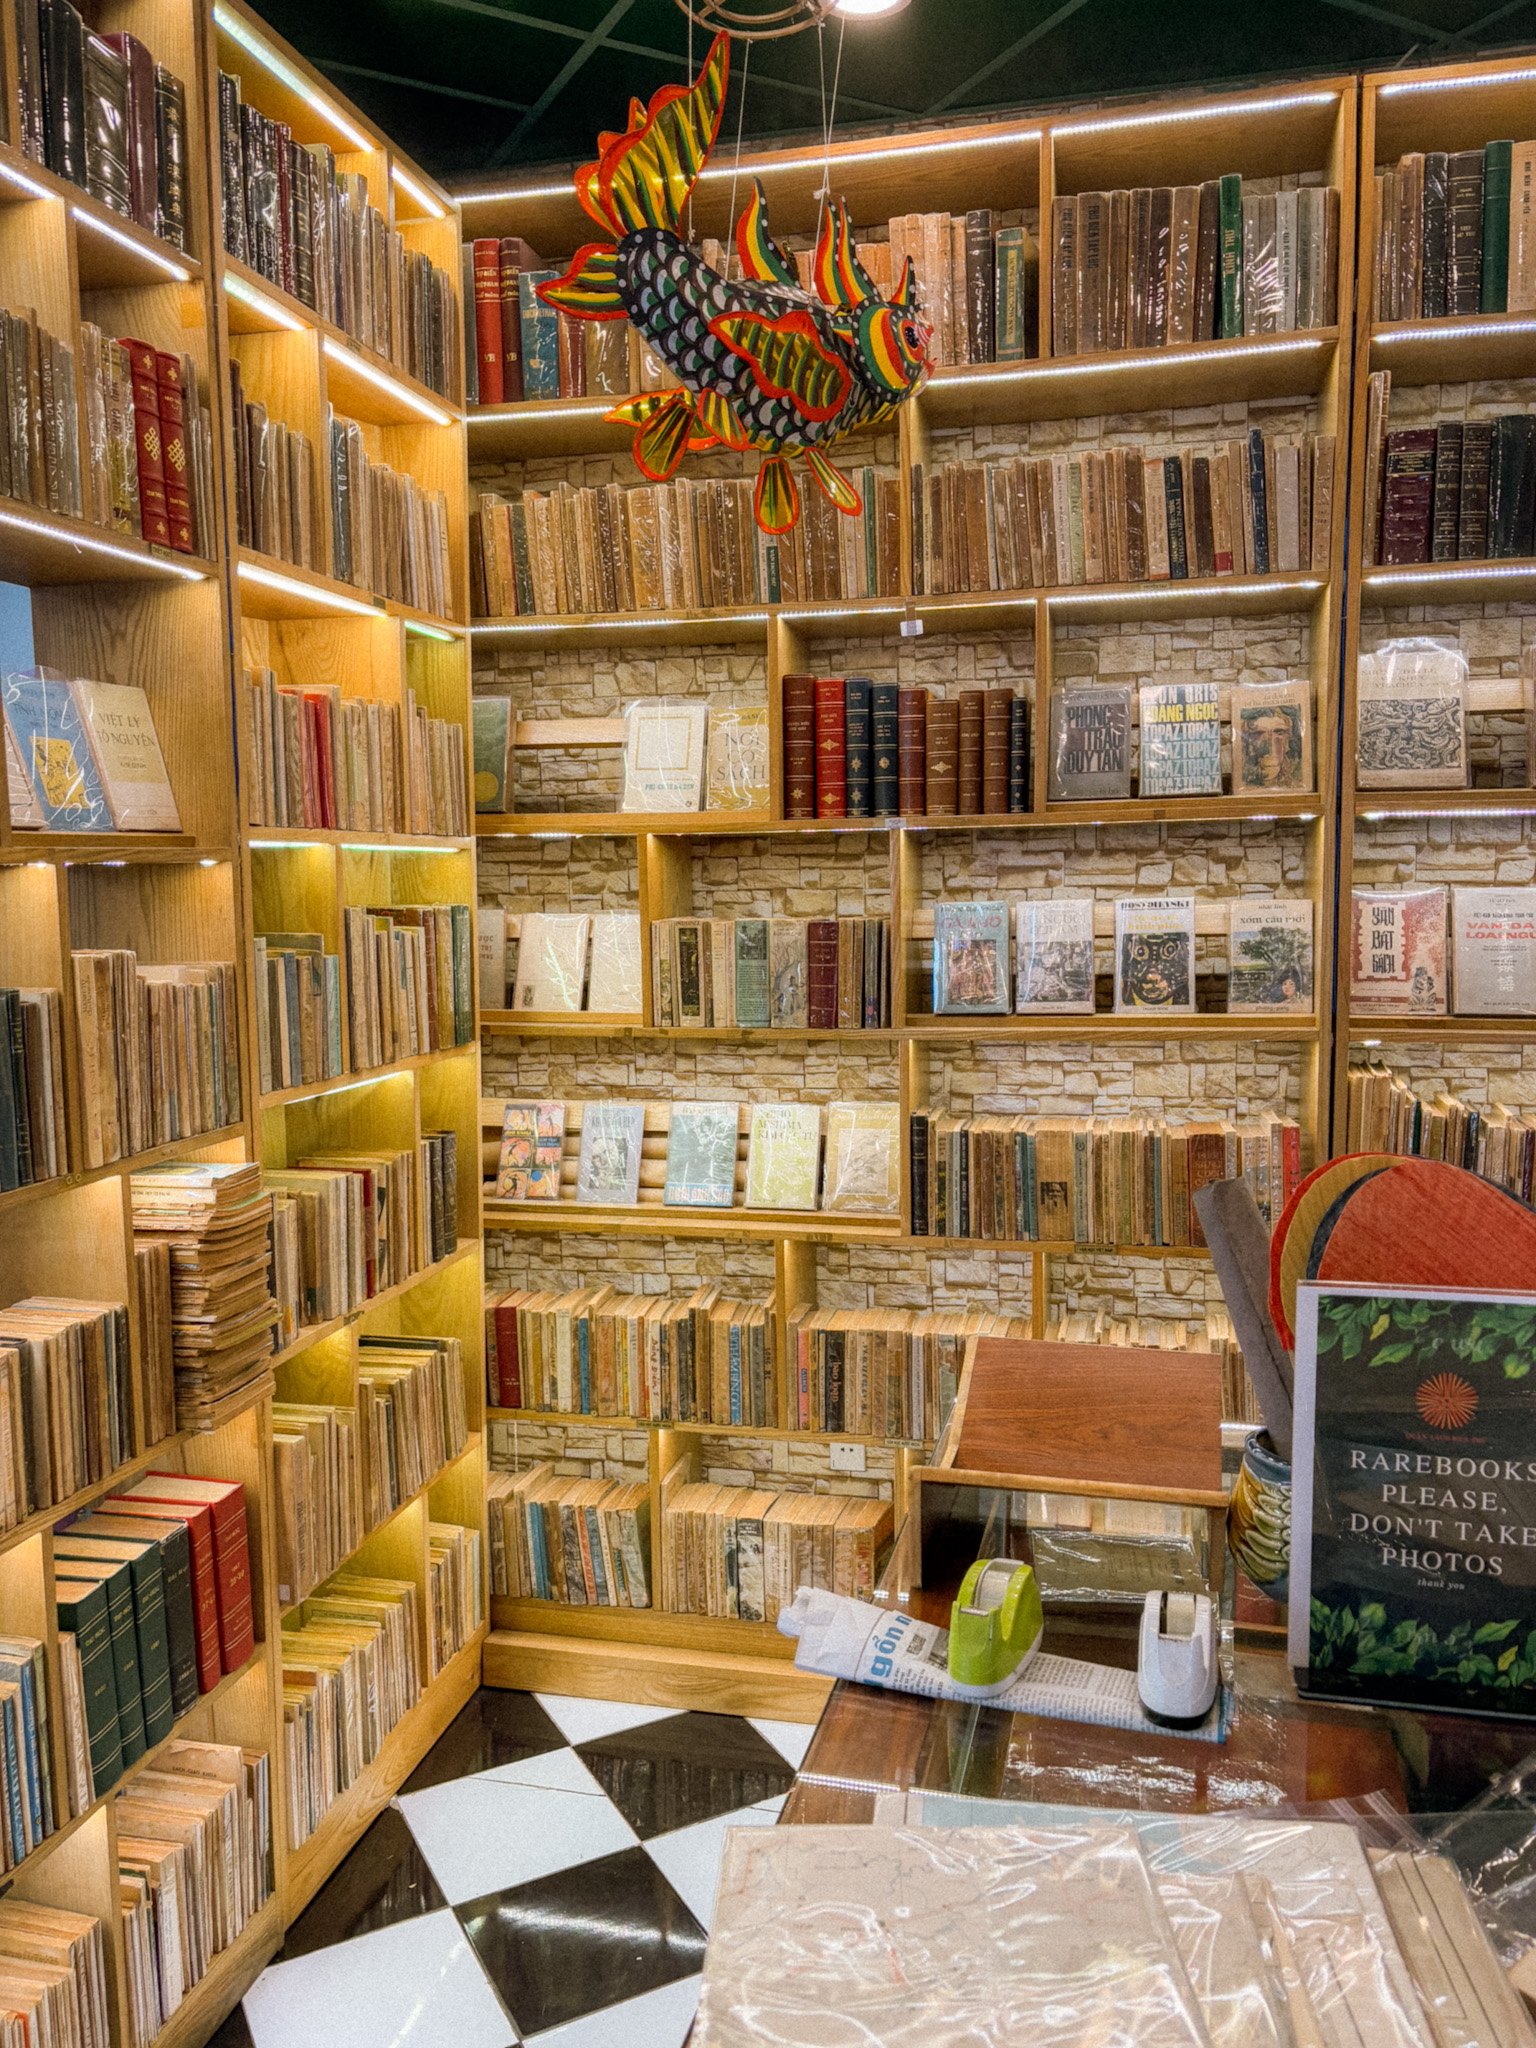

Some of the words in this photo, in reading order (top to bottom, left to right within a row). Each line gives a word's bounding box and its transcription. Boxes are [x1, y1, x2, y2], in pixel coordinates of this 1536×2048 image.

[1066, 705, 1112, 728] PHONG
[1144, 723, 1181, 741] TOPAZ
[1182, 722, 1219, 740] TOPAZ
[1182, 740, 1219, 758] TOPAZ
[1182, 758, 1219, 776] TOPAZ
[1350, 1450, 1536, 1482] RAREBOOKS
[1382, 1484, 1507, 1514] PLEASE,
[1351, 1513, 1442, 1538] DON'T
[1455, 1521, 1536, 1546] TAKE
[1382, 1547, 1503, 1576] PHOTOS
[1417, 1579, 1444, 1588] thank
[1448, 1582, 1465, 1590] you
